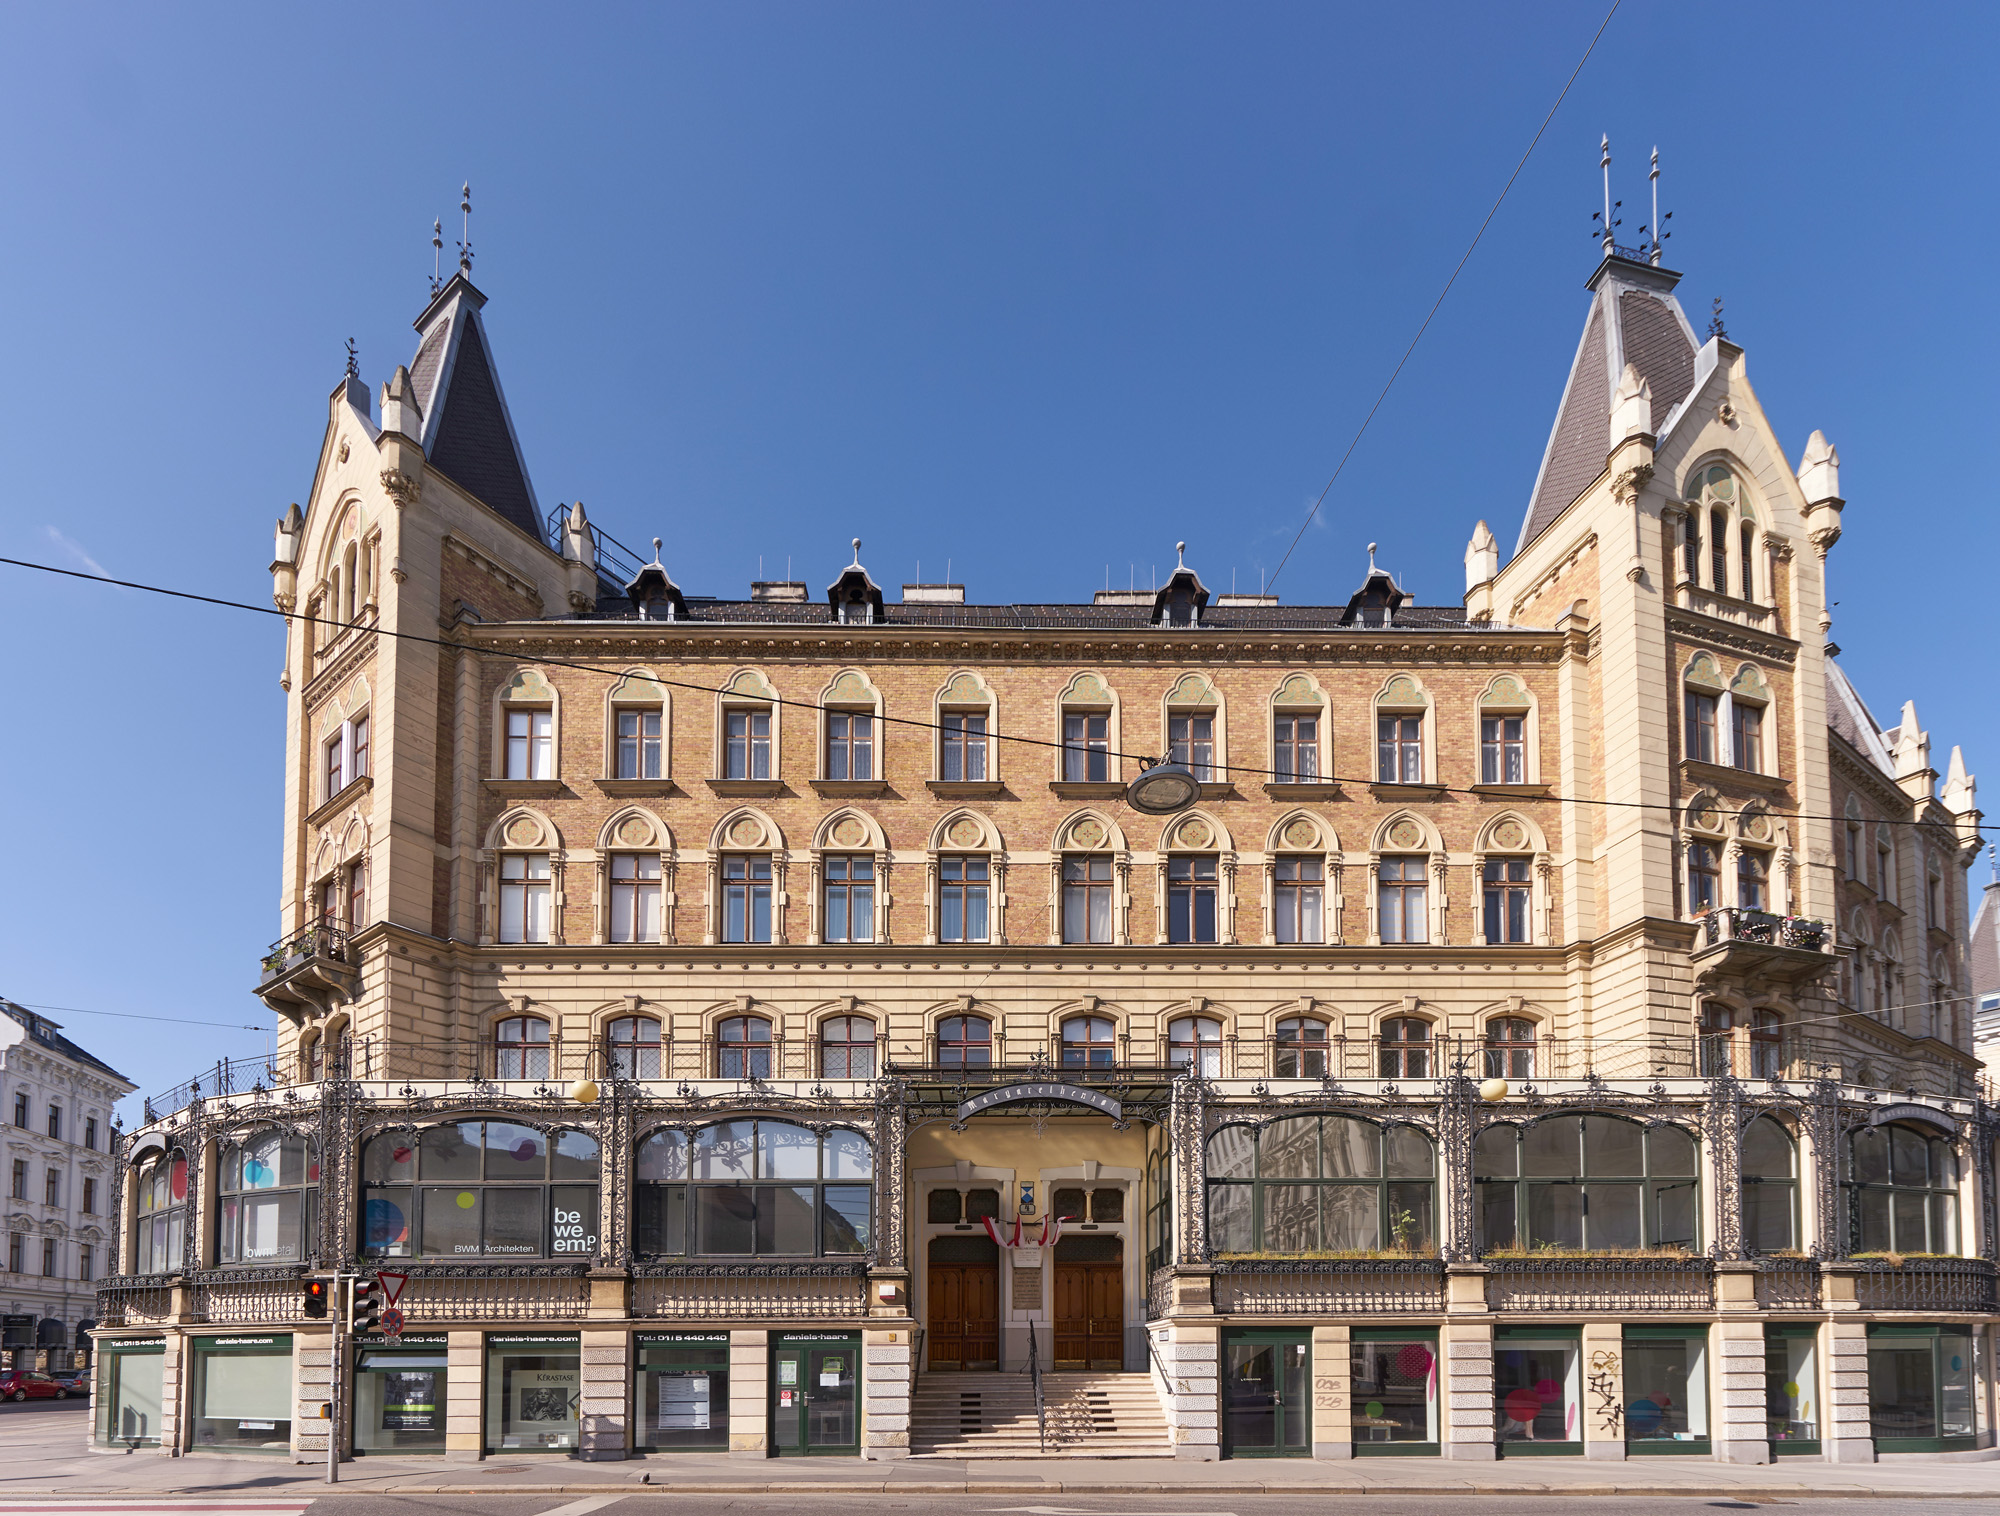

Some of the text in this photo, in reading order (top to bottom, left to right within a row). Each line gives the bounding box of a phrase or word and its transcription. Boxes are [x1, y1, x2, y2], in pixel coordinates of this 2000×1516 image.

[554, 1207, 581, 1224] be
[553, 1225, 584, 1238] we
[247, 1246, 273, 1258] bwm
[454, 1244, 534, 1253] BWM Architekten
[536, 1373, 575, 1382] KÉRASTASE
